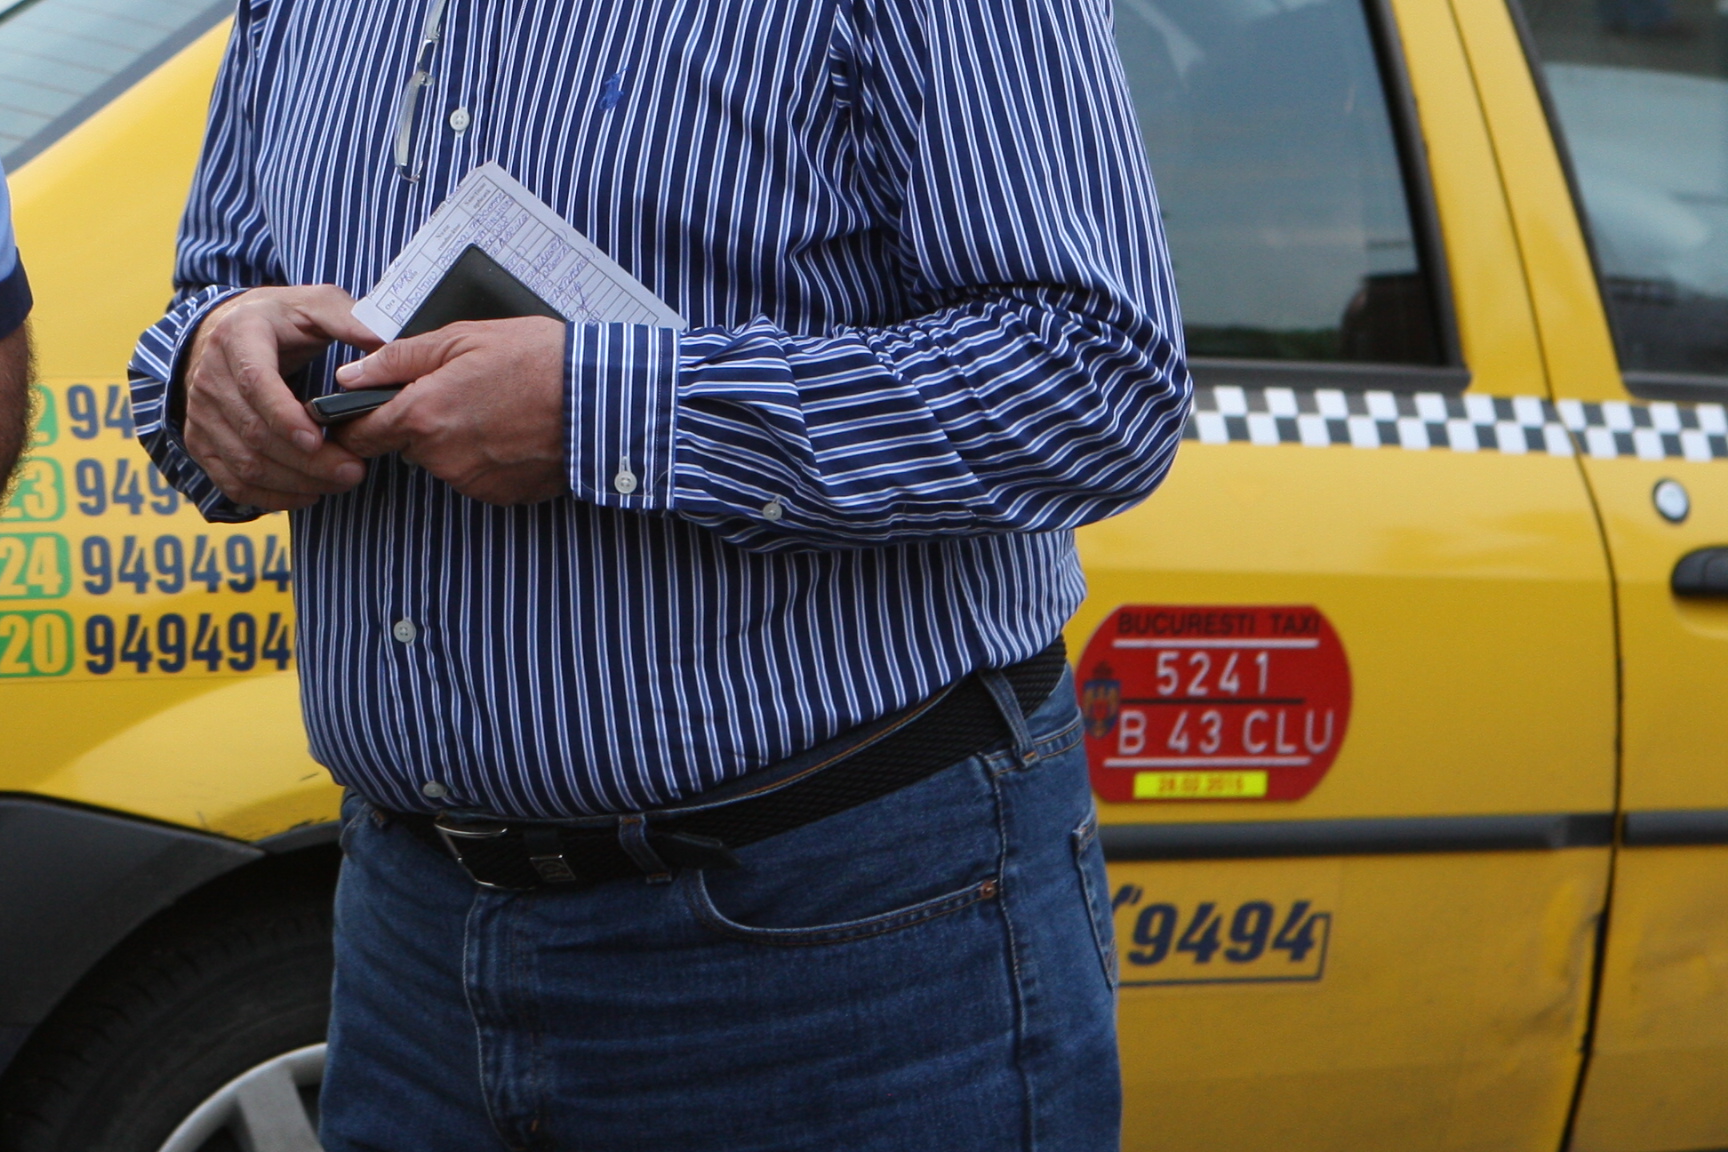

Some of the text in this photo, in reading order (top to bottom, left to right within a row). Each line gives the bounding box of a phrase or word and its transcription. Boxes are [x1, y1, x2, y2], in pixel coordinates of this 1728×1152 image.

[76, 458, 193, 517] 949
[81, 534, 291, 595] 949494
[85, 612, 291, 675] 949494
[1117, 611, 1320, 635] BUCURESTI TAXI
[1156, 651, 1269, 696] 5241
[1118, 709, 1334, 756] B 43 CLU
[1128, 899, 1315, 966] 9494
